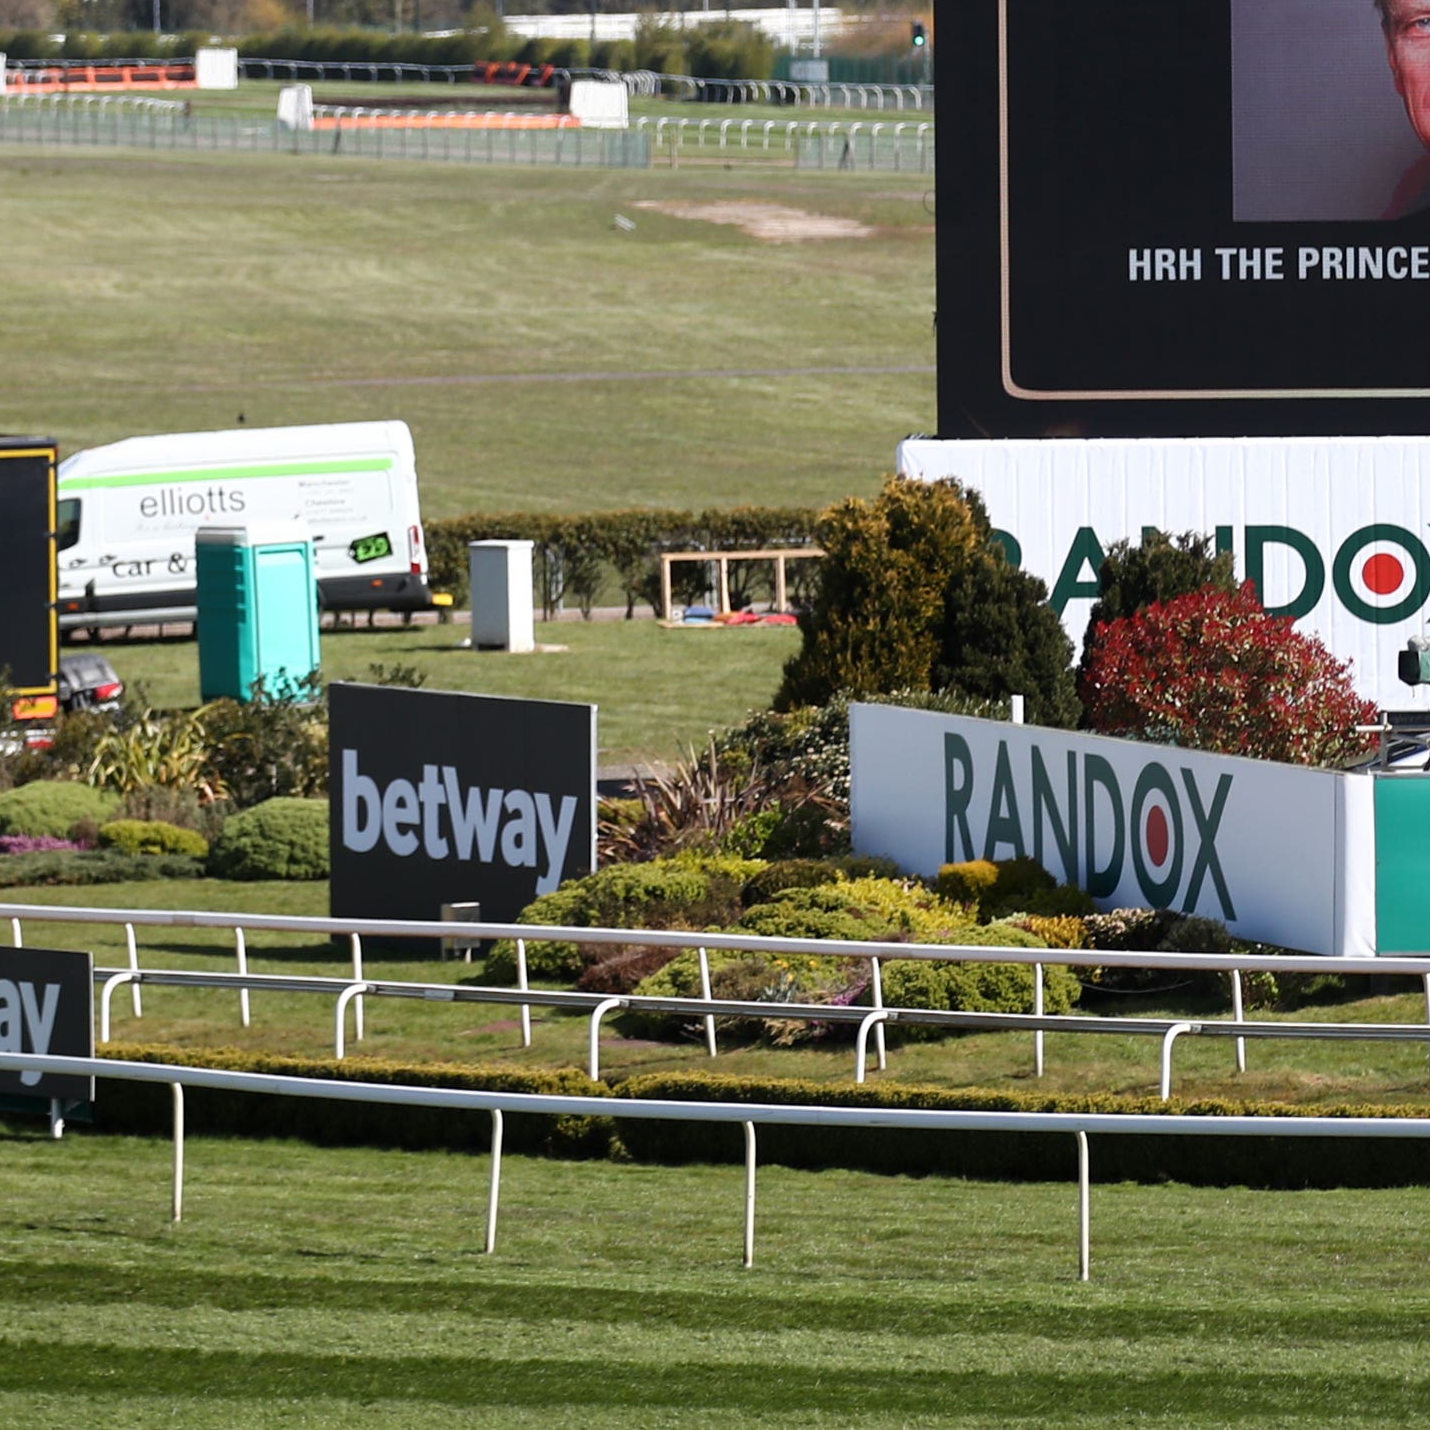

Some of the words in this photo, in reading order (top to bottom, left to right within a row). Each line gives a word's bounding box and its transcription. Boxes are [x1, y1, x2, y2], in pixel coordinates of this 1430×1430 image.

[1129, 248, 1202, 281] HRH
[1215, 247, 1284, 280] THE
[1298, 246, 1430, 279] PRINCE
[140, 486, 246, 518] elliotts
[112, 558, 156, 578] car
[168, 552, 188, 574] &
[342, 748, 578, 896] betway
[944, 732, 1237, 922] RANDOX
